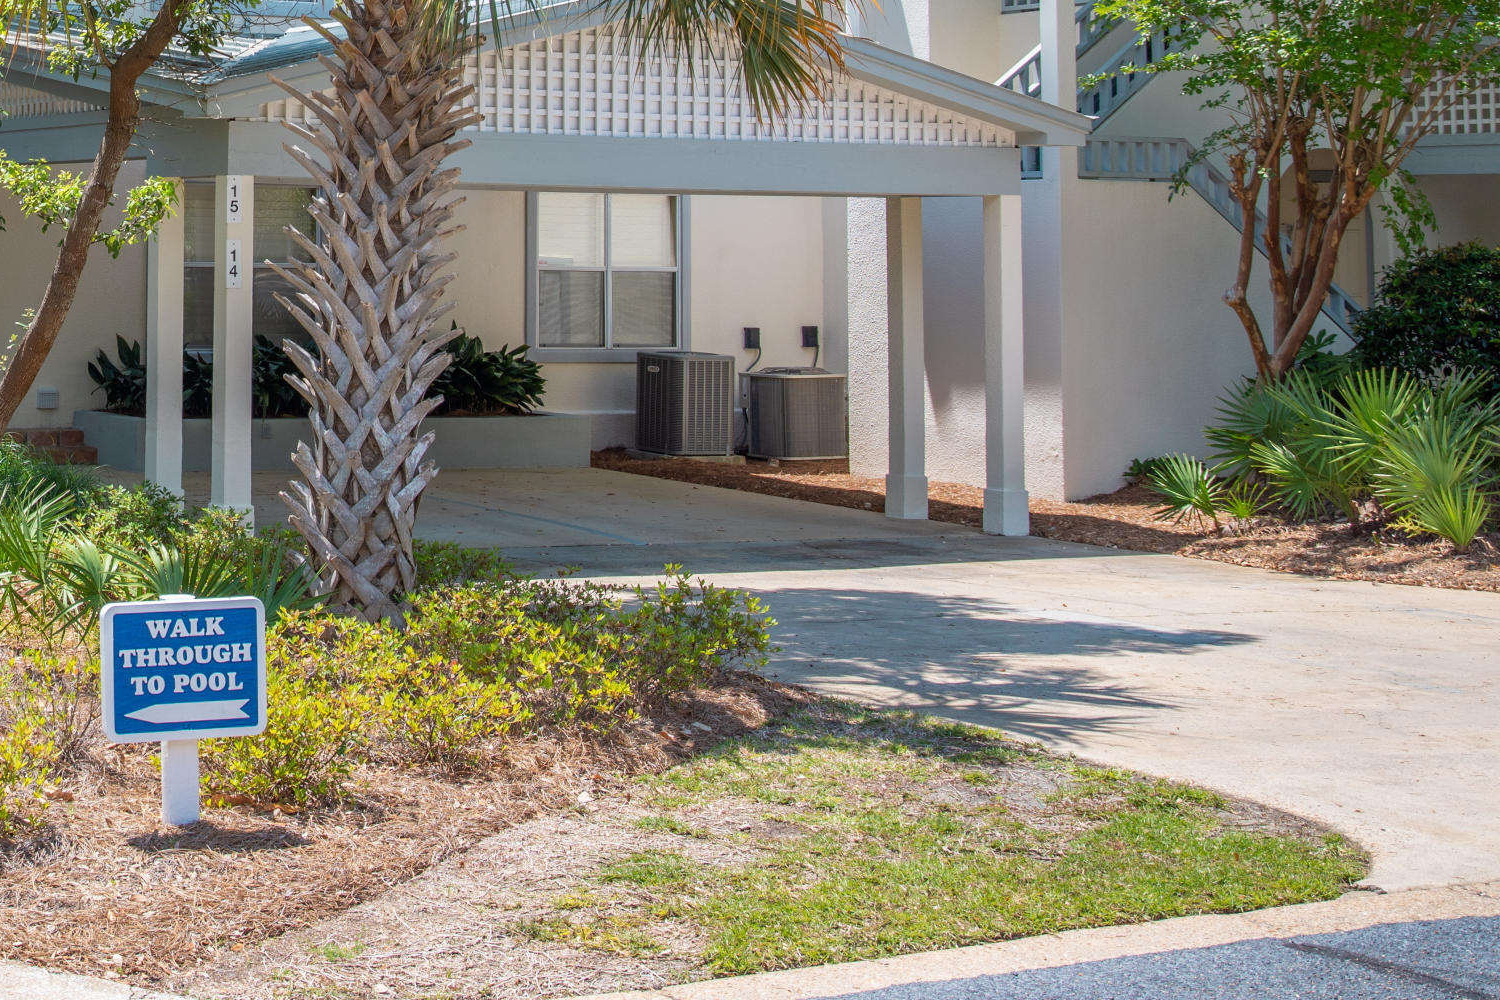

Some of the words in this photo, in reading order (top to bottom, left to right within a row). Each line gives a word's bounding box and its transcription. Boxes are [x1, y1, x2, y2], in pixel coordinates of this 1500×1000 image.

[230, 185, 239, 213] 15
[229, 249, 238, 277] 14
[145, 617, 225, 639] WALK
[118, 642, 252, 668] THROUGH
[130, 675, 166, 696] TO
[173, 672, 244, 694] POOL
